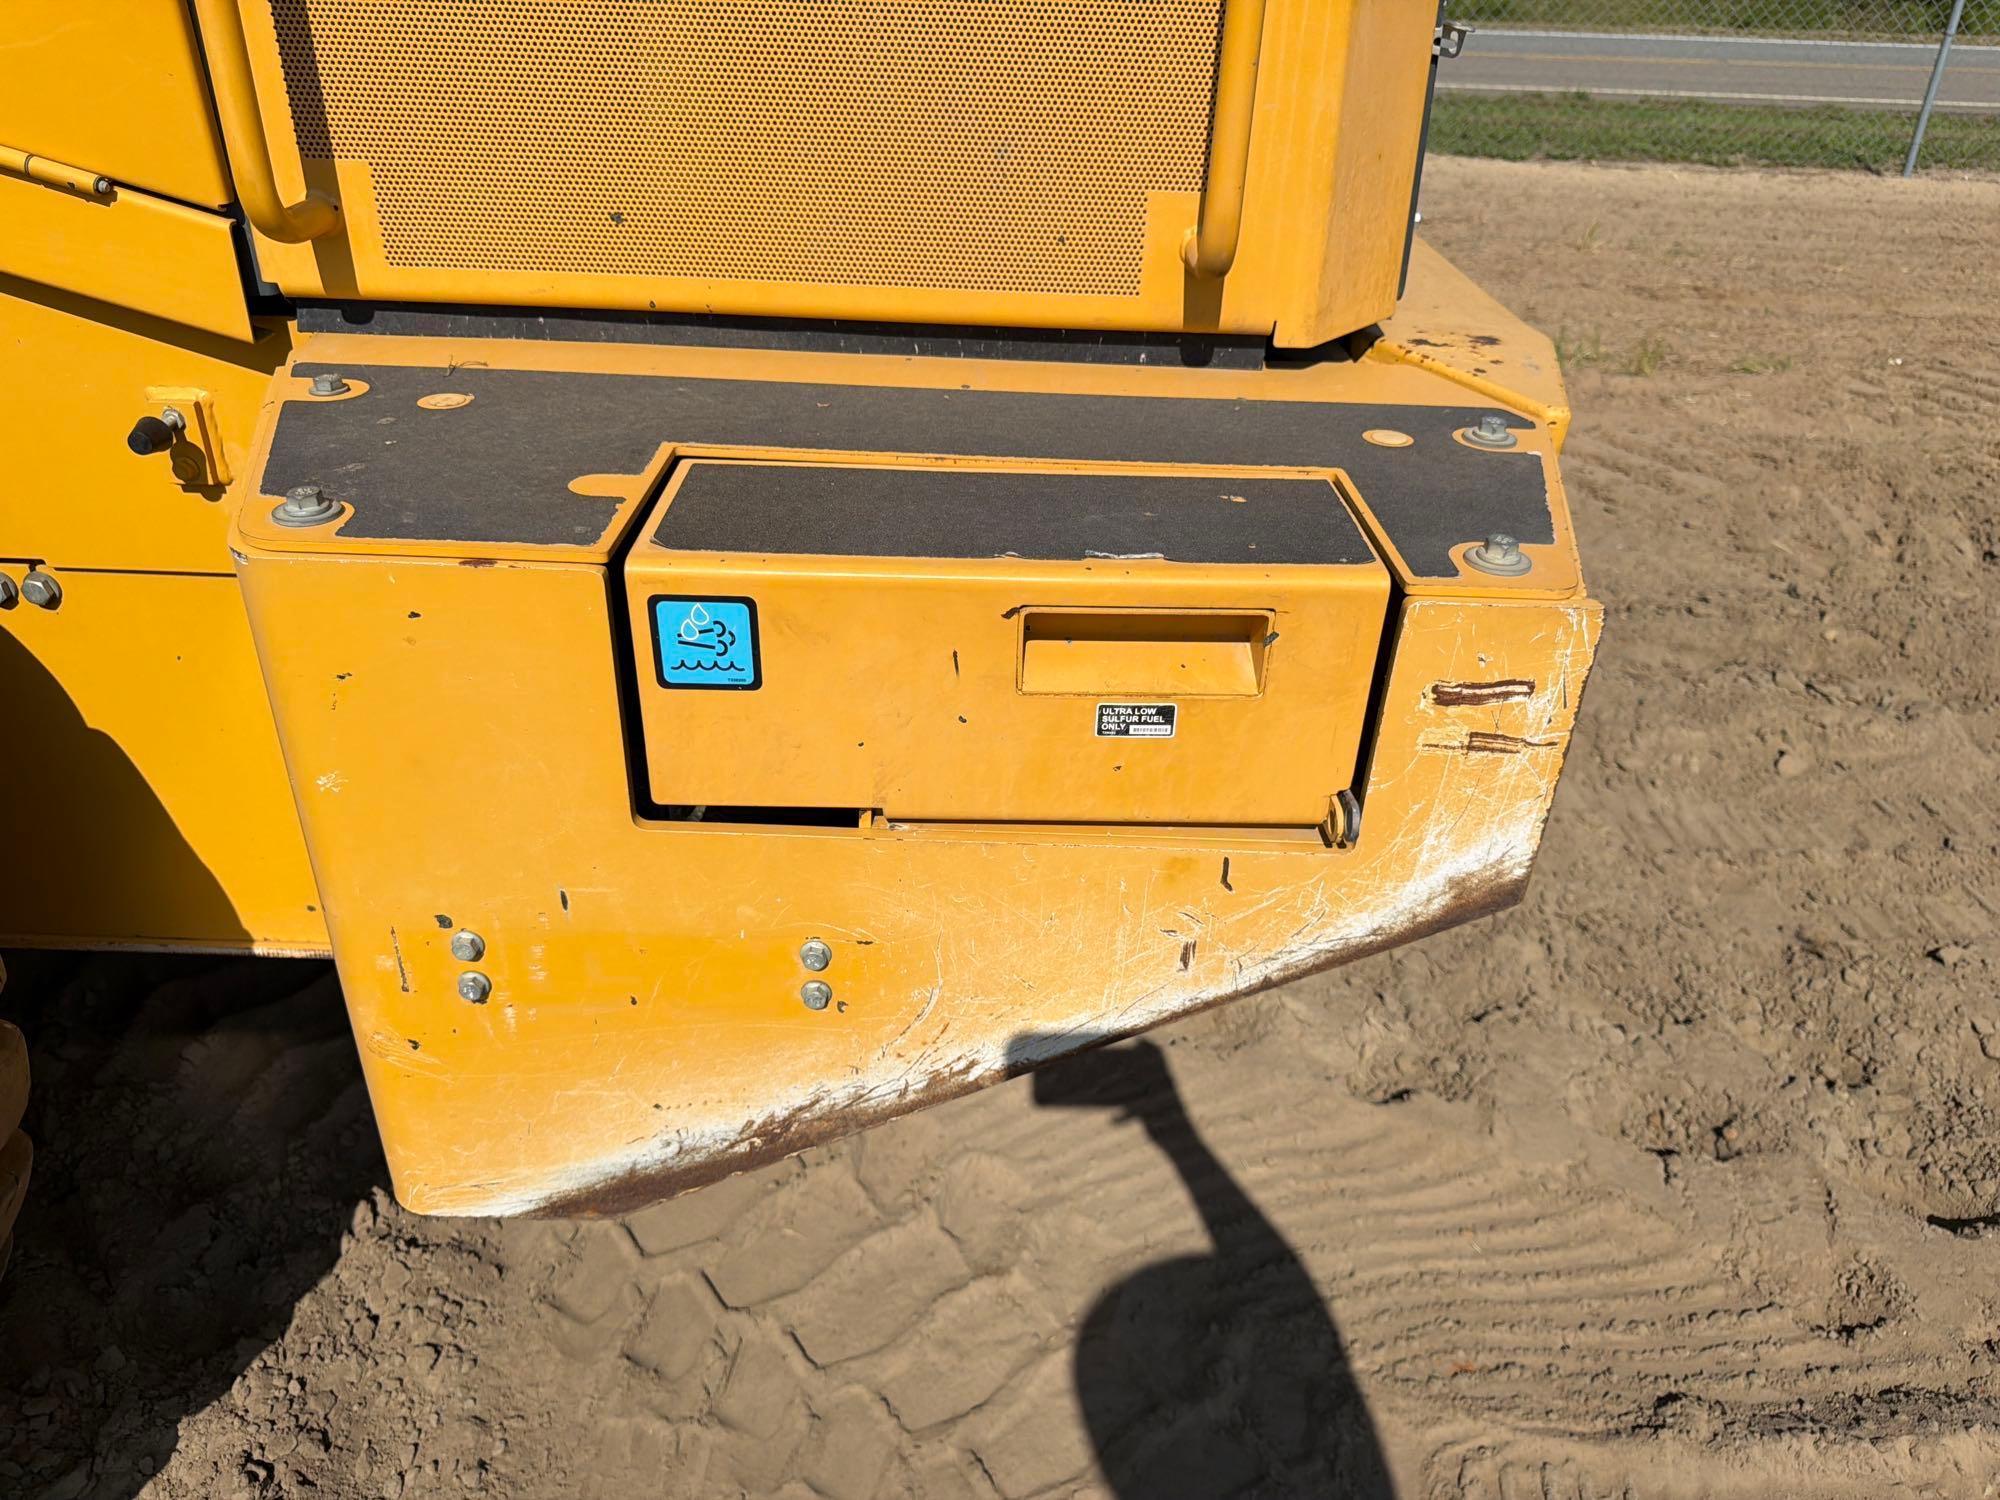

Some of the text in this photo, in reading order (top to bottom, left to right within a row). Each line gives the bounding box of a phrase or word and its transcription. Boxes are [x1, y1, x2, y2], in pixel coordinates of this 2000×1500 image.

[1102, 707, 1157, 715] ULTRA LOW
[1102, 715, 1165, 723] SULFUR FUEL
